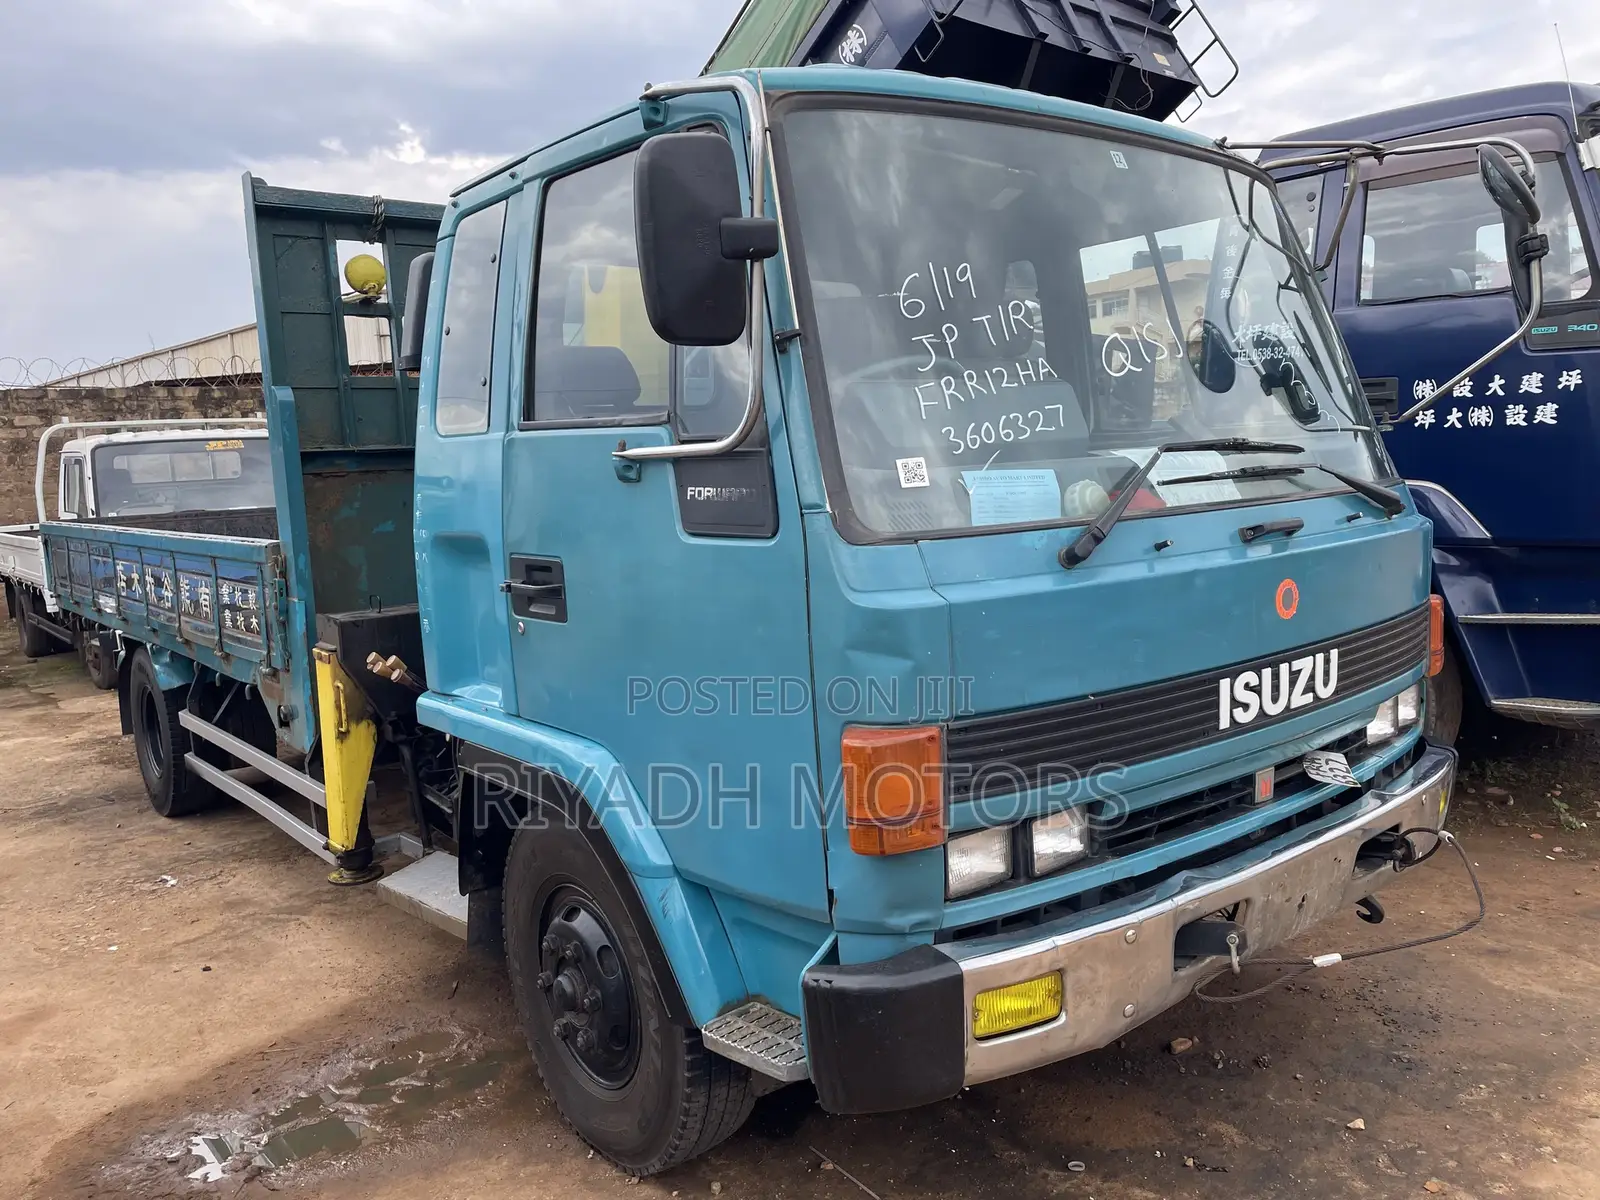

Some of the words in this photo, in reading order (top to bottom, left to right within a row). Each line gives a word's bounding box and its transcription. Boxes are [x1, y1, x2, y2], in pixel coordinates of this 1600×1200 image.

[900, 261, 977, 319] 6/19
[911, 323, 959, 372] JP
[1531, 326, 1558, 334] ISUZU
[914, 357, 1058, 420] FRR12HA
[941, 403, 1065, 455] 3606327
[1217, 648, 1339, 730] ISUZU
